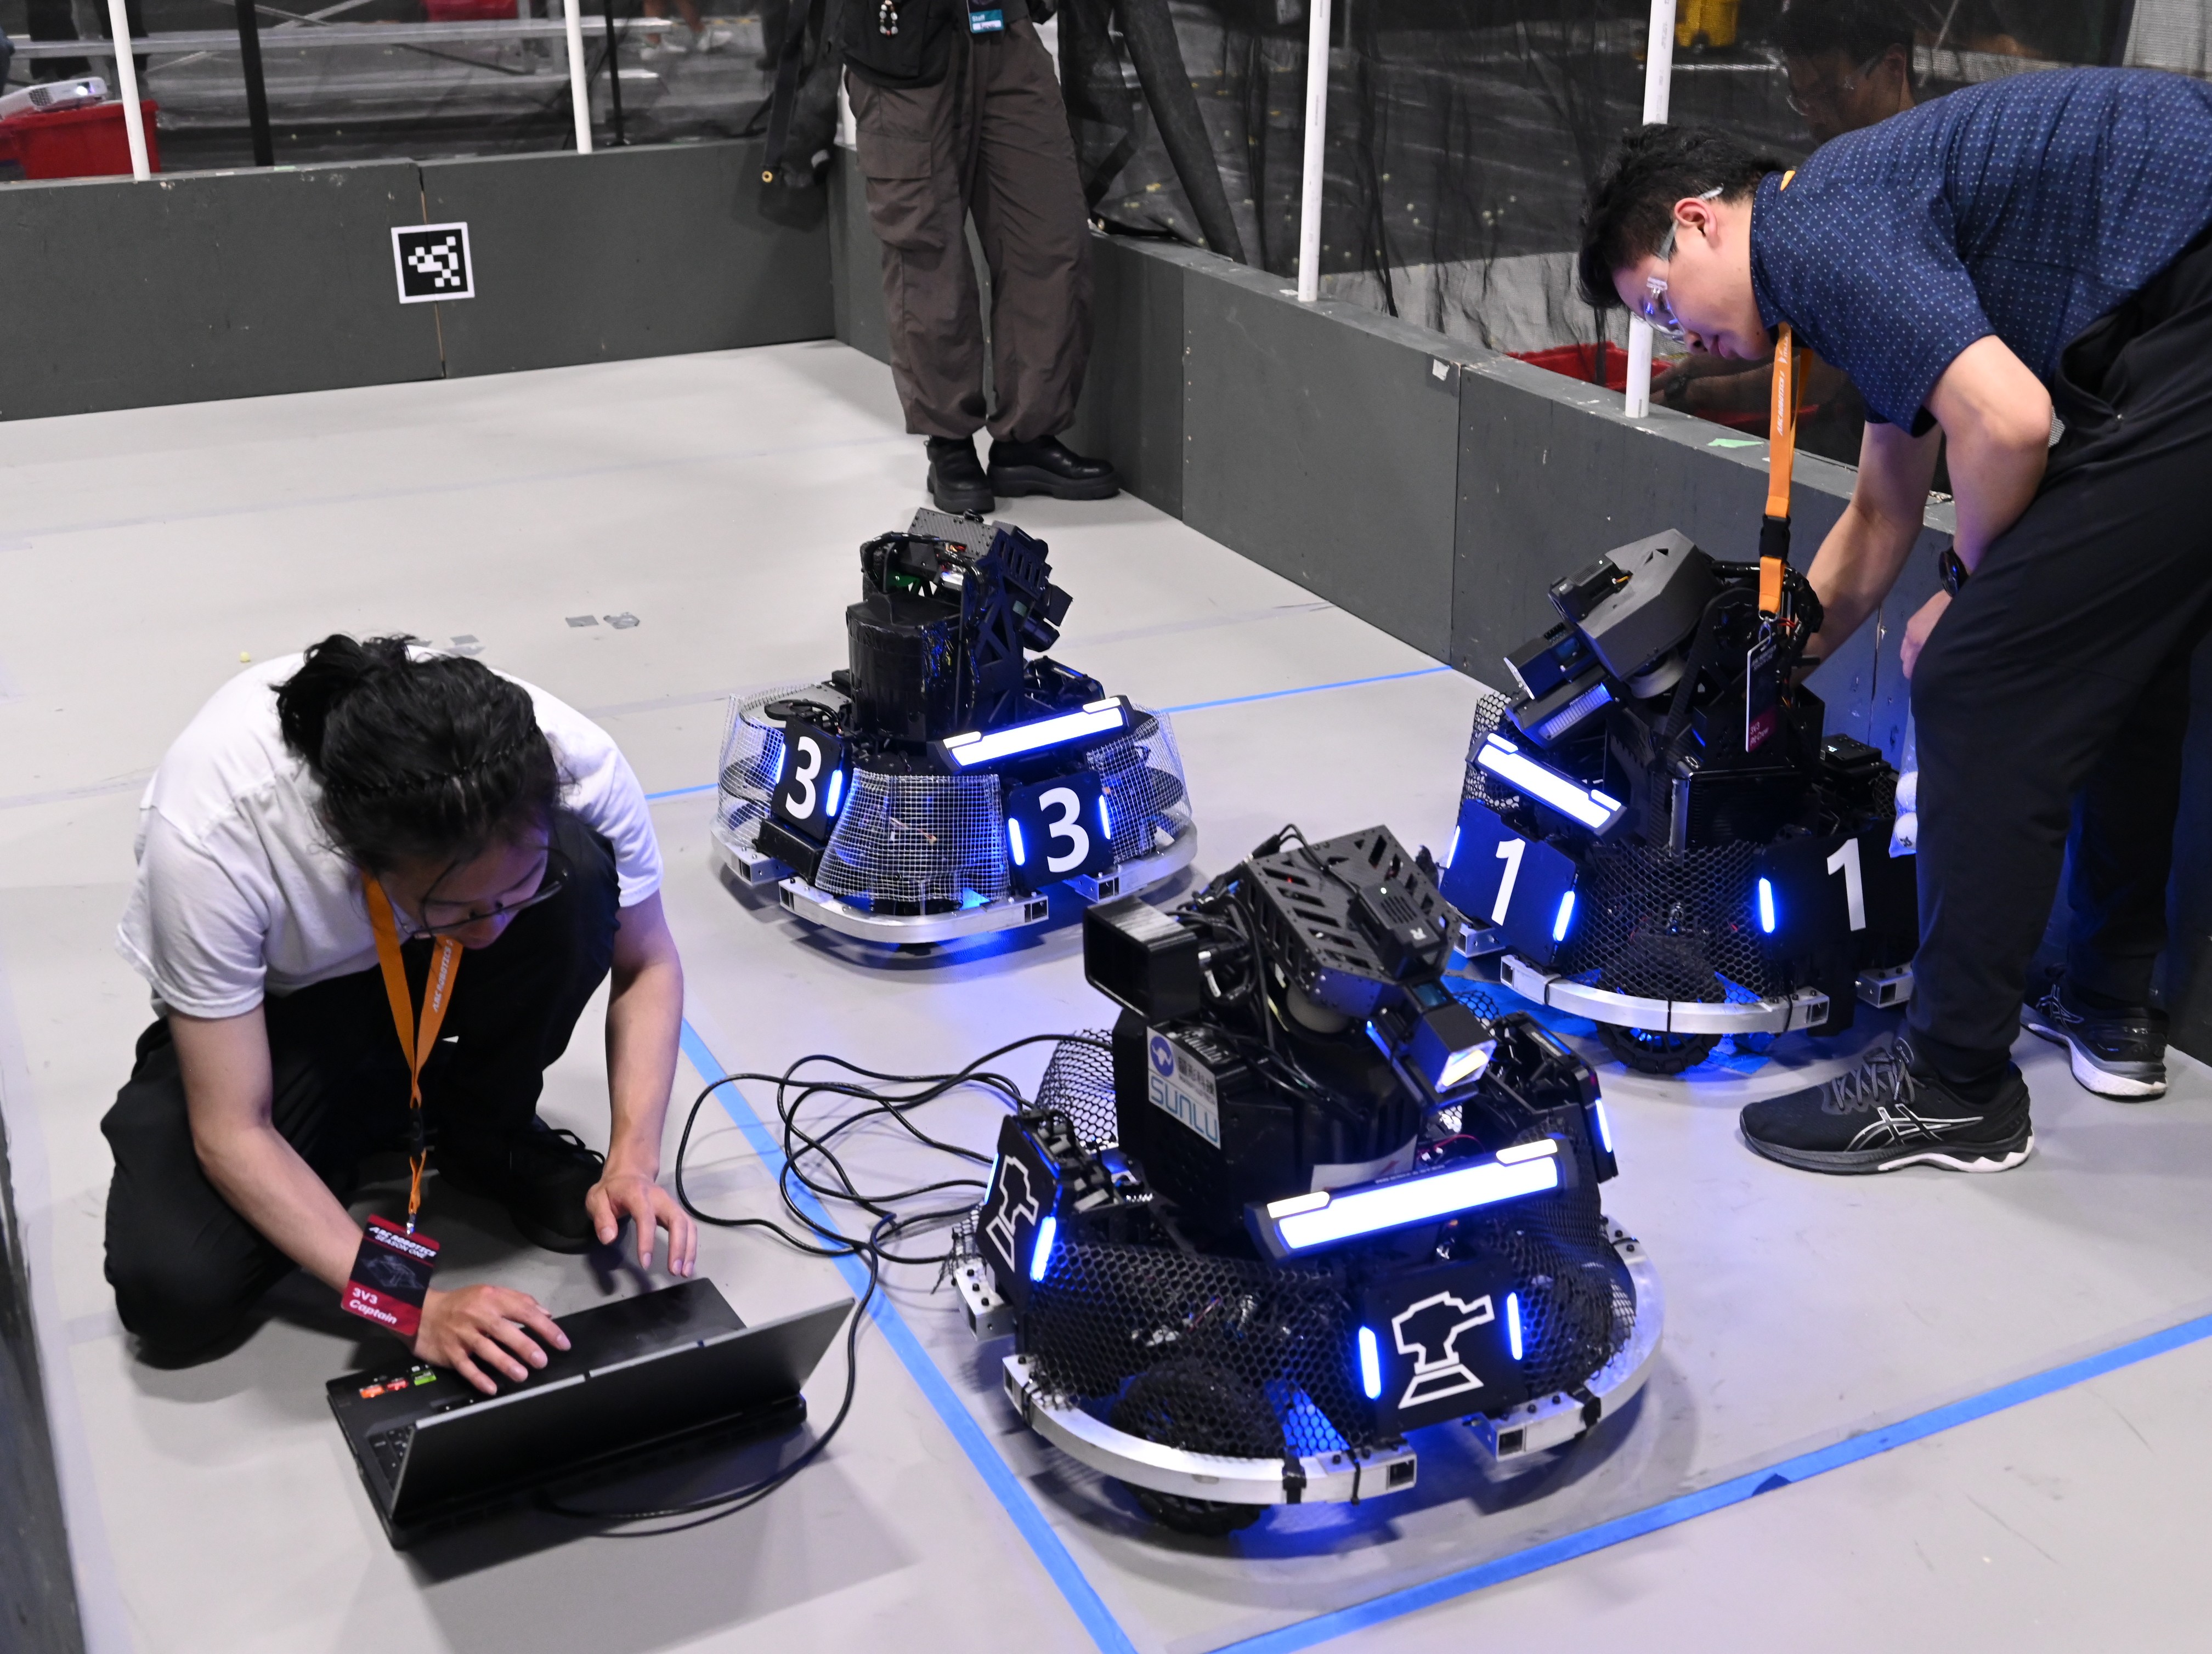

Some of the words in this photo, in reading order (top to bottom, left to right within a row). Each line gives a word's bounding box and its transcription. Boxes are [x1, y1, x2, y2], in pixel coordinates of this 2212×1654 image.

[786, 737, 821, 819] 3
[1039, 788, 1089, 872] 3
[1492, 839, 1525, 926] 1
[1828, 839, 1863, 930] 1
[1151, 1076, 1217, 1142] SUNLU
[375, 1234, 409, 1251] SEASON
[409, 1248, 427, 1259] ONE
[349, 1300, 397, 1324] Captain
[352, 1287, 378, 1305] 3V3
